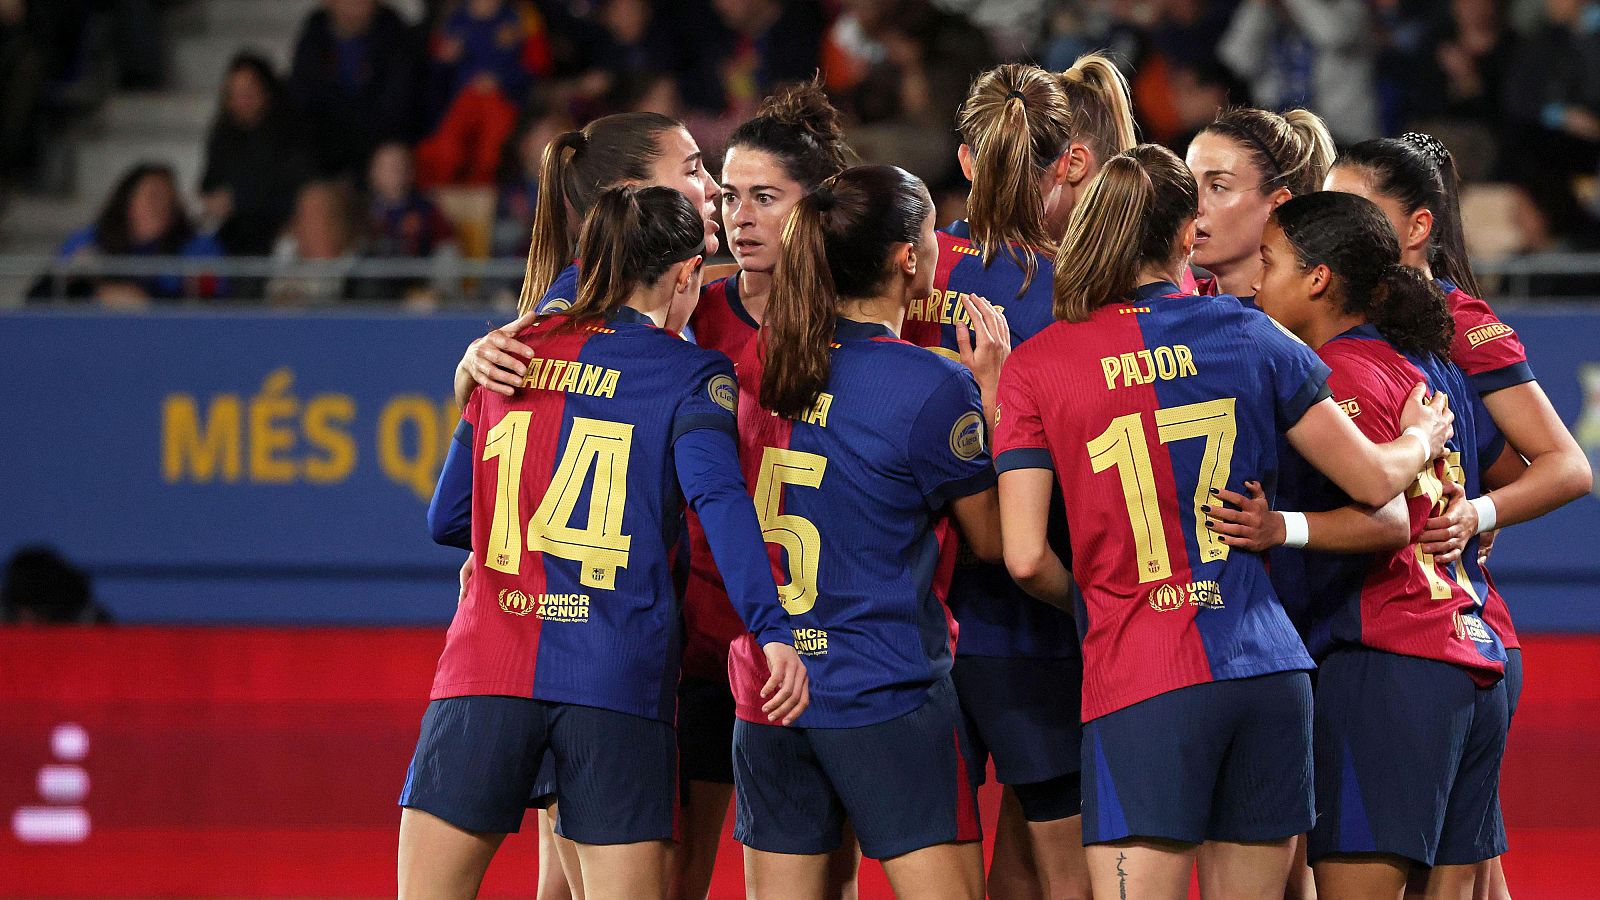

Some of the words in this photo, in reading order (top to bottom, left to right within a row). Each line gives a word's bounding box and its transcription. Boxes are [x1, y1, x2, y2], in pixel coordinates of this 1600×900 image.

[1466, 324, 1512, 345] BIMBO
[521, 358, 621, 398] AITANA
[1100, 345, 1198, 390] PAJOR
[162, 366, 357, 482] MÉS
[377, 392, 462, 505] Q
[482, 410, 635, 591] 14
[1086, 397, 1237, 584] 17
[753, 446, 828, 616] 5
[535, 605, 589, 618] ACNUR
[538, 593, 590, 606] UNHCR
